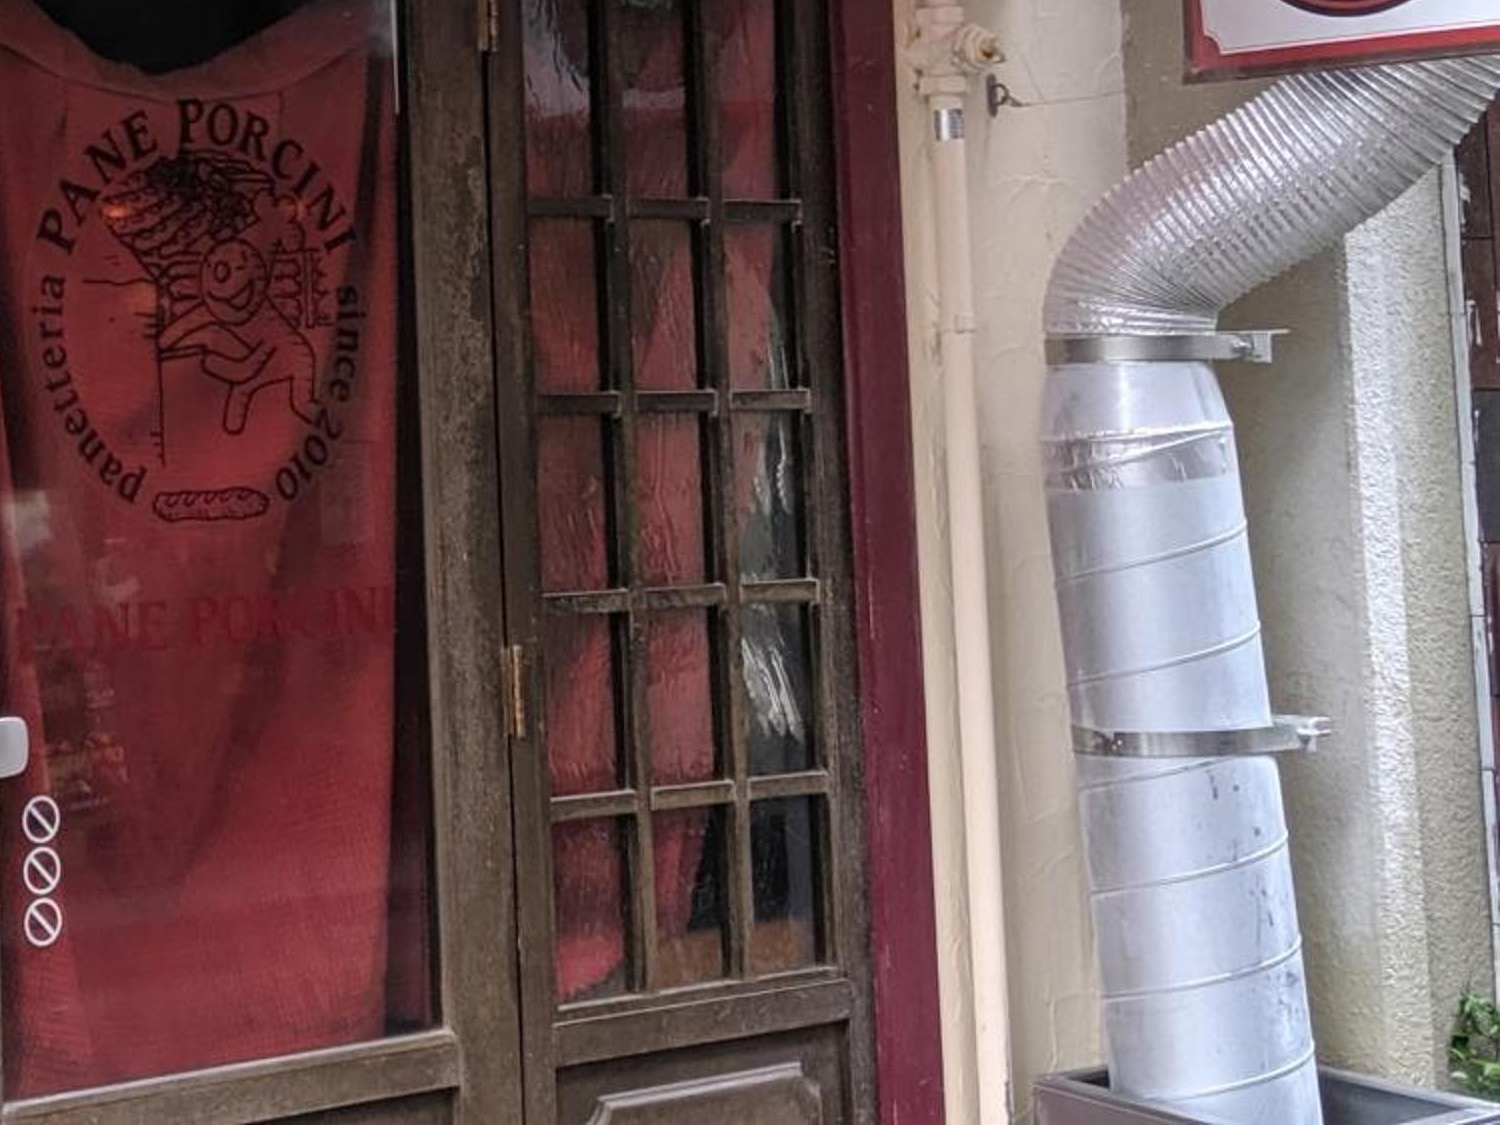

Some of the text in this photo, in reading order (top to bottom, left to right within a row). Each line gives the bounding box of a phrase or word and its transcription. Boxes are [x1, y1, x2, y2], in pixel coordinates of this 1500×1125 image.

[37, 98, 358, 255] PANE PORCINI
[32, 274, 149, 504] panetteria
[275, 285, 367, 501] since 2010
